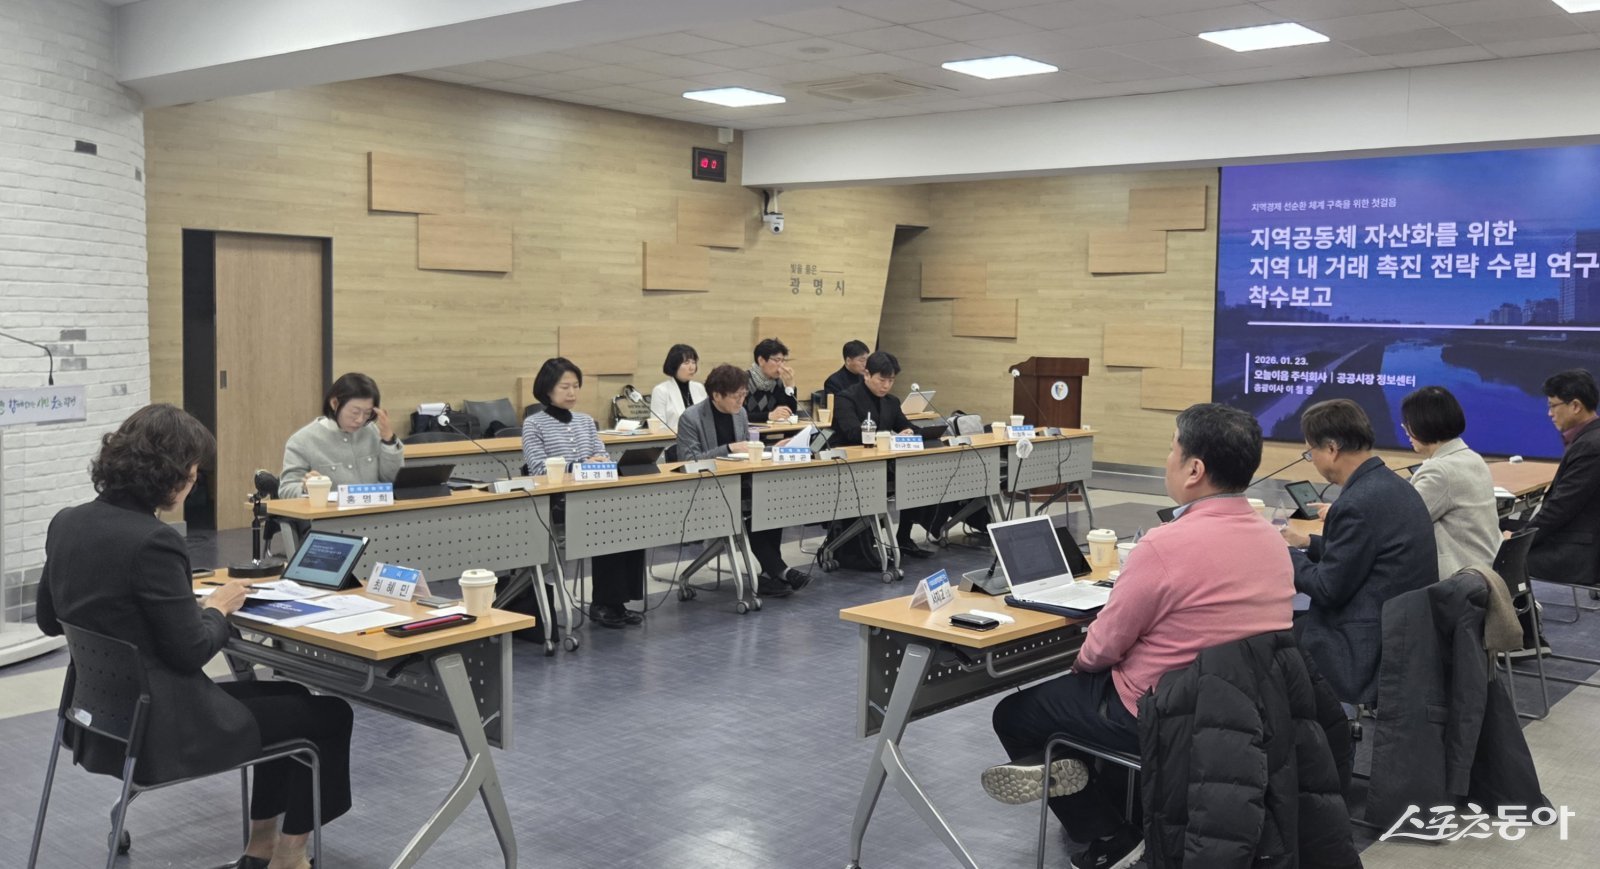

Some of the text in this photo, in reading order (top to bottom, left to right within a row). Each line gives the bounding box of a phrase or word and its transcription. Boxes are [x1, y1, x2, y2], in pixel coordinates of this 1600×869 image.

[1251, 197, 1396, 212] 지역경제 선순환 체계 구축을 위한 첫걸음
[1250, 219, 1517, 250] 지역공동체 자산화를 위한
[1249, 251, 1600, 280] 지역 내 거래 촉진 전략 수립 연구
[1248, 285, 1333, 309] 착수보고
[1254, 355, 1309, 366] 2026. 01. 23.
[1253, 369, 1416, 387] 오늘이음 주식회사 공공시장 정보센터
